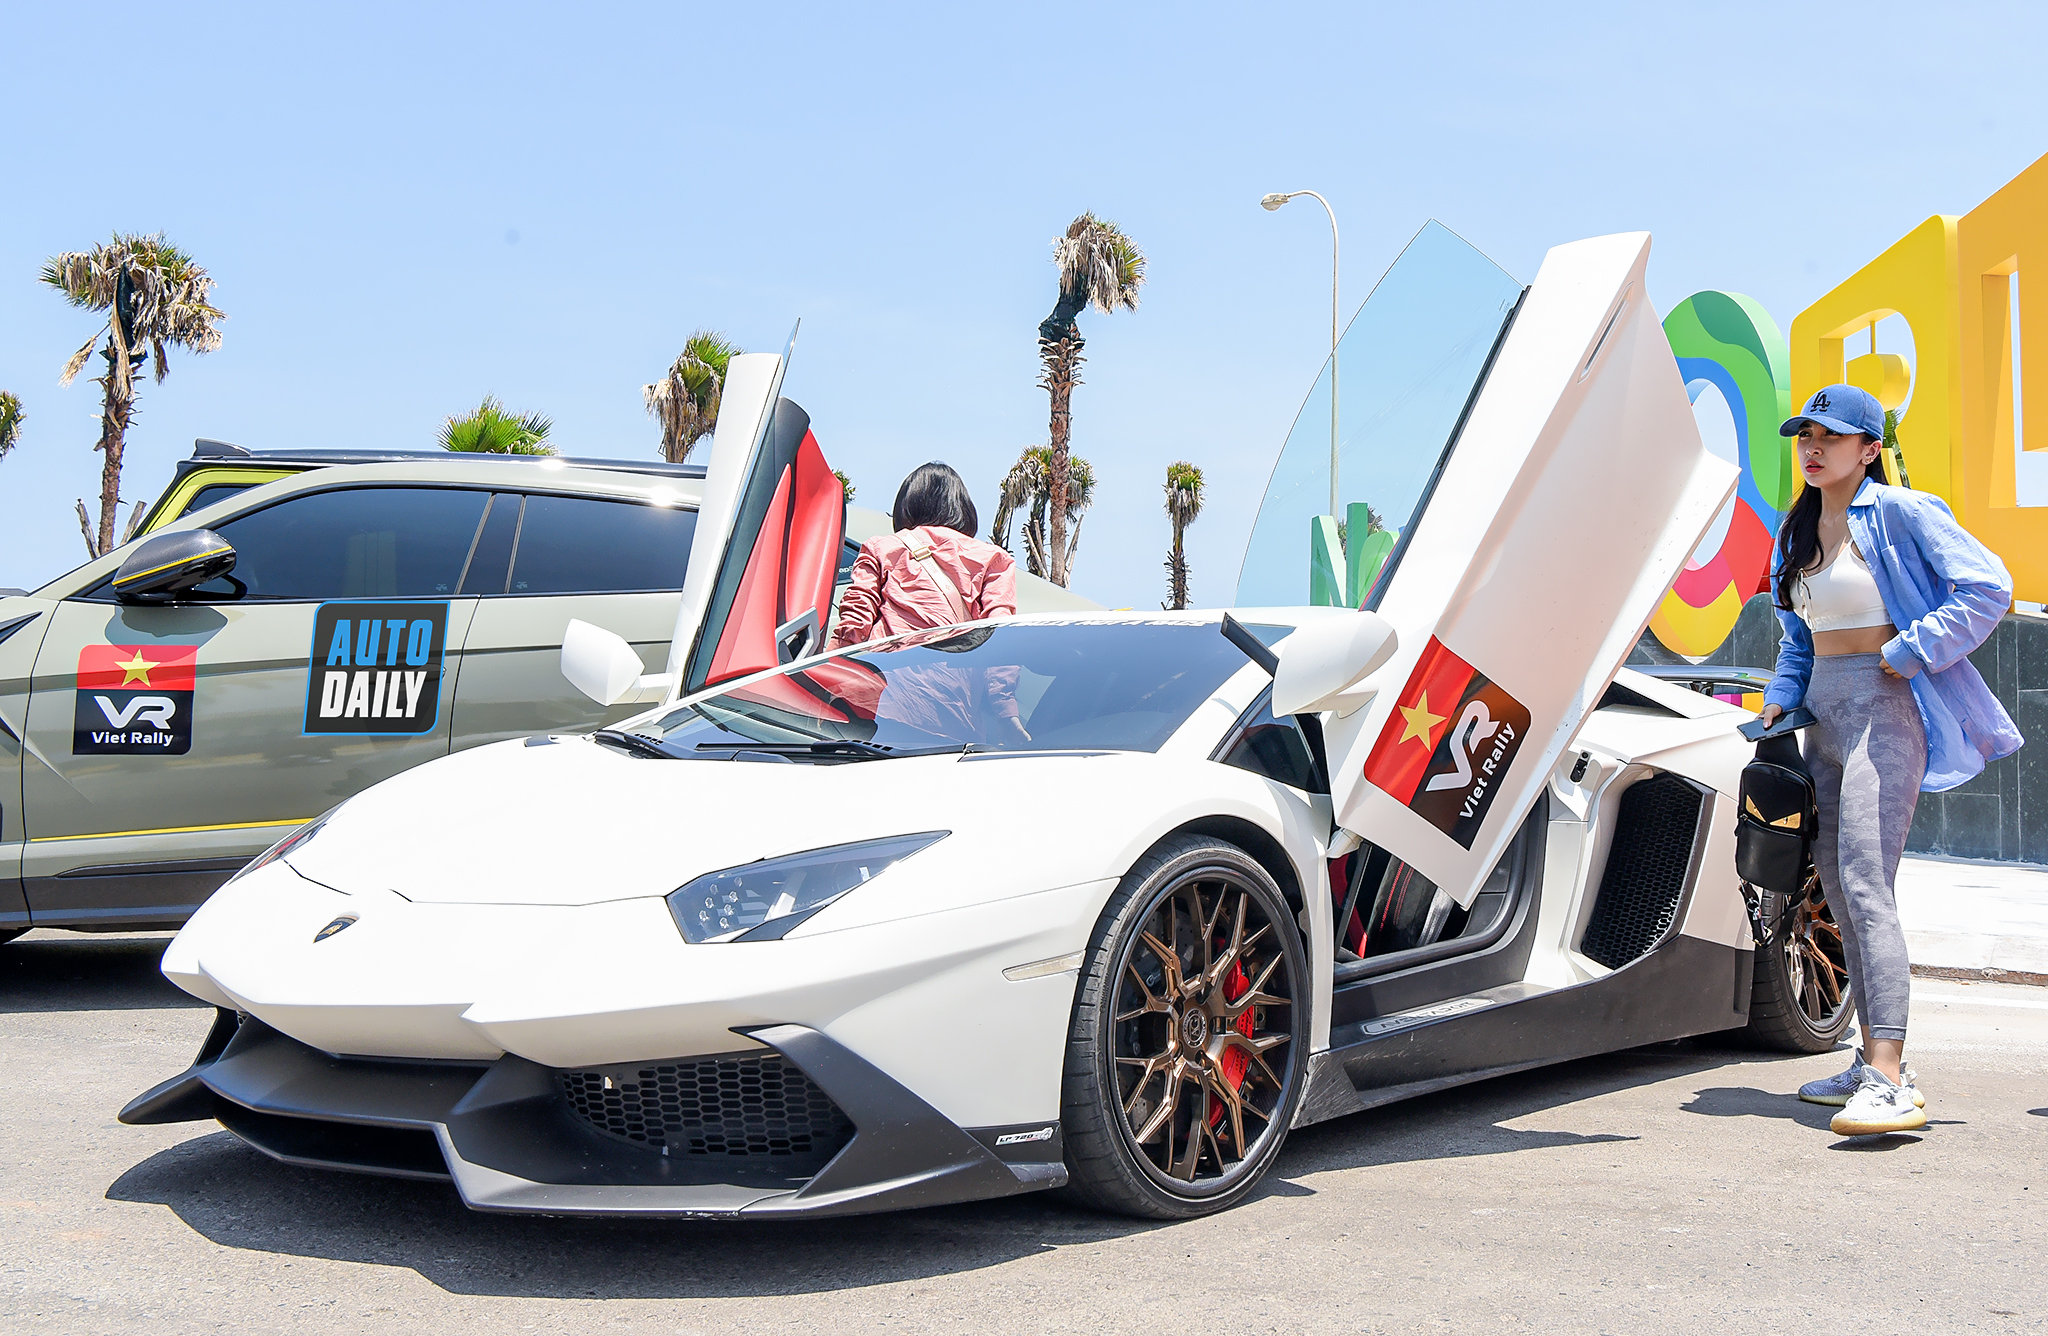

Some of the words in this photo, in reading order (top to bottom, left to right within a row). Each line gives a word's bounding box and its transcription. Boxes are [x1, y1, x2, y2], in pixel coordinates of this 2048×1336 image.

[1809, 391, 1832, 412] LA
[326, 619, 433, 666] AUTO
[93, 695, 176, 729] VR
[319, 671, 427, 718] DAILY
[91, 731, 127, 744] Viet
[130, 731, 174, 747] Rally
[1425, 700, 1500, 792] VR
[1459, 777, 1488, 819] Viet
[1481, 722, 1516, 776] Rally
